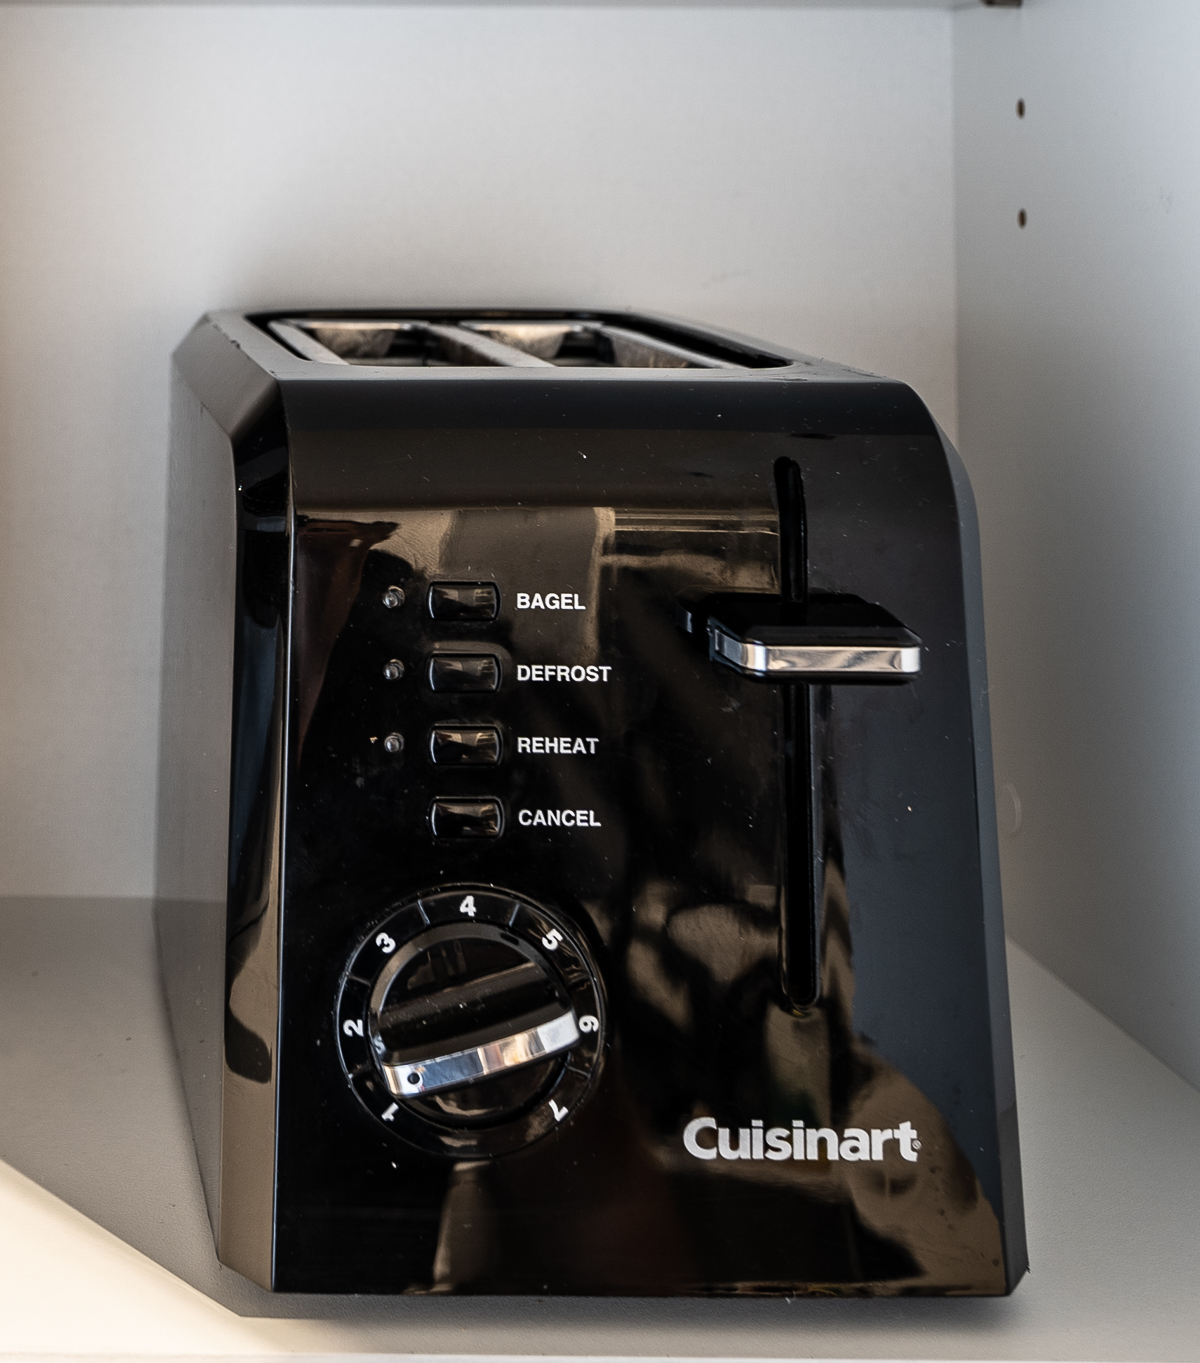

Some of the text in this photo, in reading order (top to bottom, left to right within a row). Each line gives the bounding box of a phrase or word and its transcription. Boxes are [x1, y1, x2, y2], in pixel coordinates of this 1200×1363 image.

[516, 592, 587, 610] BAGEL
[516, 664, 612, 682] DEFROST
[517, 737, 600, 754] REHEAT
[518, 809, 602, 827] CANCEL
[459, 895, 477, 917] 4
[375, 932, 397, 954] 3
[541, 928, 564, 951] 5
[342, 1018, 365, 1037] 2
[381, 1102, 400, 1122] 1
[548, 1099, 569, 1122] 7
